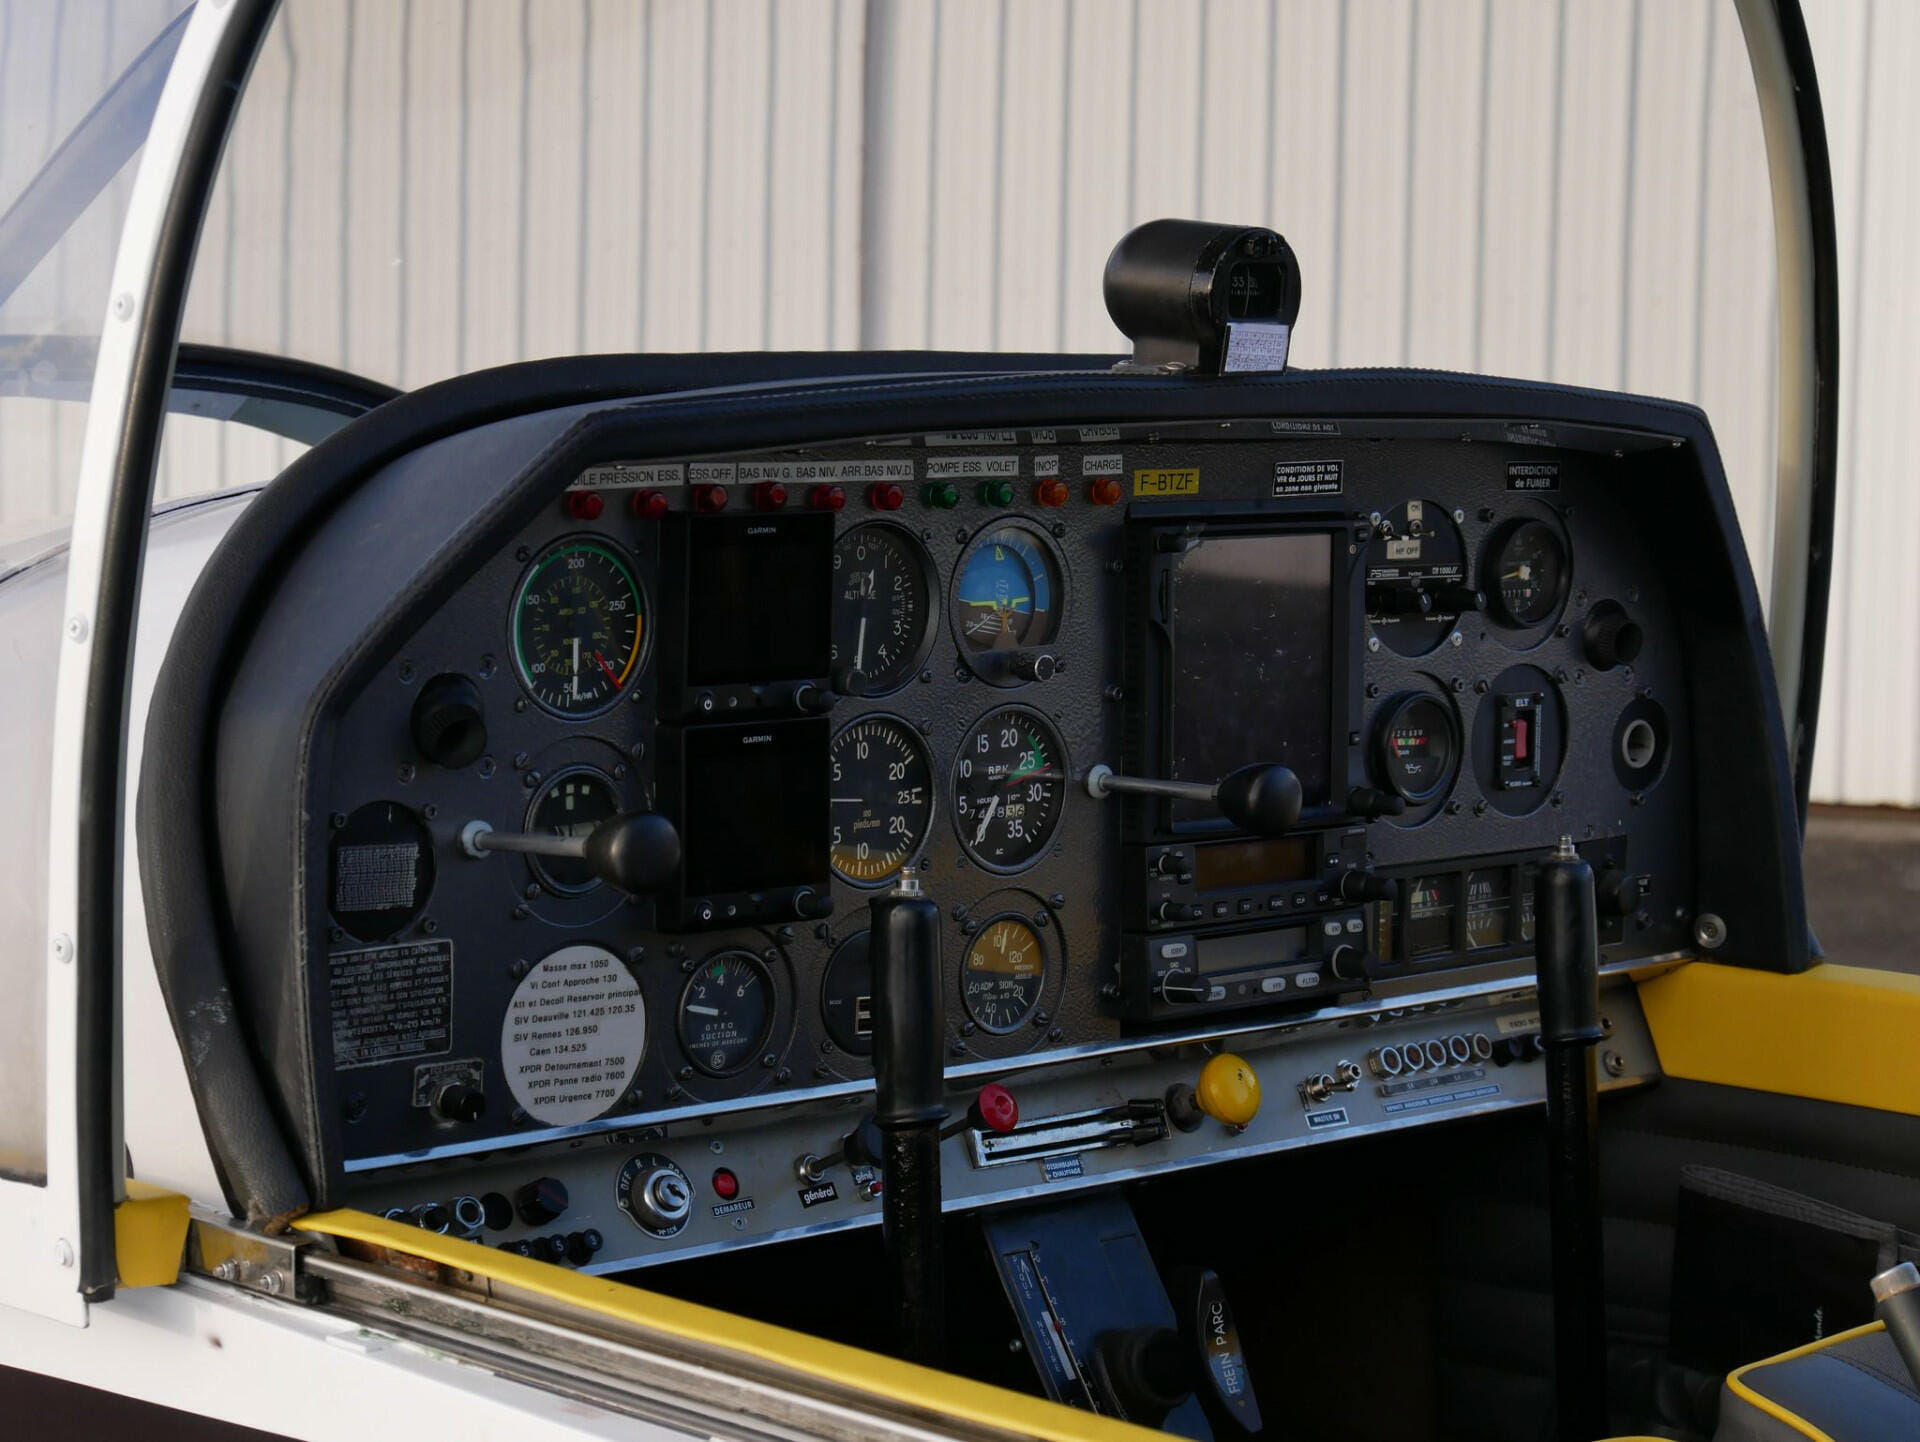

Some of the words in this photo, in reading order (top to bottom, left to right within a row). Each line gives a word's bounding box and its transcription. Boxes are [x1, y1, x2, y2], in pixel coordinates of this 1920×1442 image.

[796, 466, 816, 478] BAS
[819, 466, 838, 477] NIV.
[864, 465, 884, 476] BAS
[927, 462, 960, 473] POMPE
[986, 460, 1018, 472] VOLET
[1035, 460, 1058, 472] INOP
[1084, 459, 1122, 471] CHARGE
[1276, 465, 1315, 474] CONDITIONS
[1317, 464, 1325, 472] DE
[1327, 464, 1339, 472] VOL
[1508, 465, 1558, 476] INTERDICTION
[573, 473, 597, 486] UILE
[600, 471, 654, 485] PRESSION
[658, 469, 681, 482] ESS.
[740, 467, 760, 479] BAS
[1297, 474, 1315, 482] JOURS
[1317, 473, 1323, 481] ET
[1324, 473, 1338, 481] NUIT
[1141, 472, 1194, 492] F-BTZF
[1515, 478, 1525, 488] de
[1526, 478, 1551, 488] FUMER
[747, 527, 777, 535] GARMIN
[856, 546, 866, 561] 0
[568, 559, 585, 569] 200
[833, 554, 842, 570] 9
[893, 575, 902, 591] 2
[525, 594, 540, 605] 150
[609, 600, 626, 611] 250
[893, 620, 902, 636] 3
[877, 643, 887, 658] 4
[531, 662, 546, 673] 100
[1515, 698, 1530, 707] ELT
[742, 735, 772, 744] GARMIN
[977, 734, 990, 753] 15
[1001, 728, 1018, 748] 20
[856, 742, 869, 760] 10
[1019, 751, 1035, 770] 25
[832, 763, 842, 782] 5
[888, 763, 905, 780] 20
[960, 759, 972, 778] 10
[1026, 783, 1042, 803] 30
[959, 795, 967, 814] 5
[888, 816, 905, 834] 20
[1007, 819, 1023, 839] 35
[833, 826, 842, 844] 5
[857, 842, 869, 860] 10
[972, 952, 984, 966] 80
[1009, 950, 1022, 963] 120
[543, 964, 568, 972] Masse
[570, 962, 587, 970] max
[590, 959, 609, 969] 1050
[530, 981, 538, 989] Vi
[541, 979, 560, 988] Conf
[563, 976, 600, 987] Approche
[603, 974, 618, 983] 130
[716, 974, 724, 986] 4
[968, 981, 979, 994] 60
[699, 986, 706, 999] 2
[736, 985, 745, 997] 6
[1012, 984, 1024, 997] 20
[513, 1000, 525, 1009] Att
[528, 1000, 537, 1008] et
[539, 996, 564, 1006] Decoll
[567, 993, 605, 1003] Reservoir
[985, 1002, 997, 1014] 40
[514, 1016, 529, 1025] SIV
[532, 1012, 569, 1023] Deauville
[573, 1007, 605, 1018] 121.425
[608, 1004, 636, 1014] 120.35
[514, 1033, 529, 1042] SIV
[531, 1031, 562, 1041] Rennes
[566, 1025, 598, 1036] 126.950
[701, 1030, 737, 1041] SUCTION
[529, 1046, 551, 1057] Caen
[554, 1043, 587, 1054] 134.525
[519, 1064, 542, 1073] XPDR
[605, 1056, 625, 1066] 7500
[528, 1079, 551, 1089] XPDR
[553, 1077, 578, 1086] Panne
[581, 1074, 602, 1083] radio
[605, 1071, 625, 1081] 7600
[534, 1095, 556, 1105] XPDR
[559, 1092, 592, 1104] Urgence
[595, 1088, 615, 1099] 7700
[635, 1158, 643, 1169] R
[620, 1172, 632, 1191] OFF
[803, 1184, 835, 1205] général
[713, 1200, 753, 1216] DEMAREUR
[1211, 1302, 1227, 1346] PARC
[1220, 1352, 1241, 1395] FREIN
